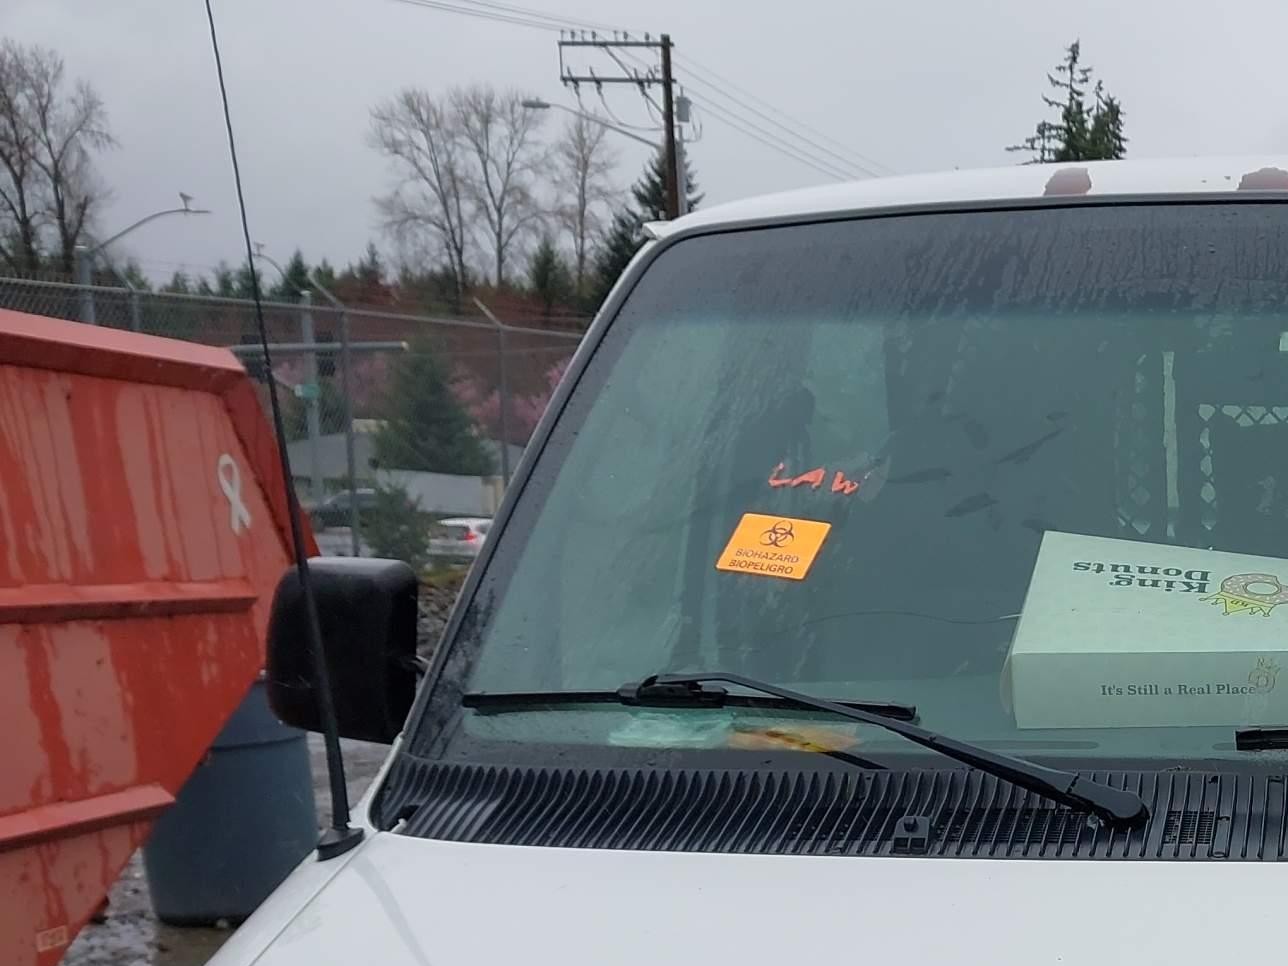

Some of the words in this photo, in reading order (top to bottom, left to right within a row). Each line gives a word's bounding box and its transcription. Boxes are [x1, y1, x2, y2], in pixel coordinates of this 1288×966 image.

[735, 548, 800, 564] BIOHAZARD
[728, 559, 794, 575] BIOPELIGRO
[1072, 561, 1211, 582] Donuts
[1108, 573, 1210, 593] King
[1101, 684, 1123, 696] It's
[1127, 684, 1159, 696] Still
[1178, 684, 1211, 695] Real
[1216, 684, 1257, 695] Place
